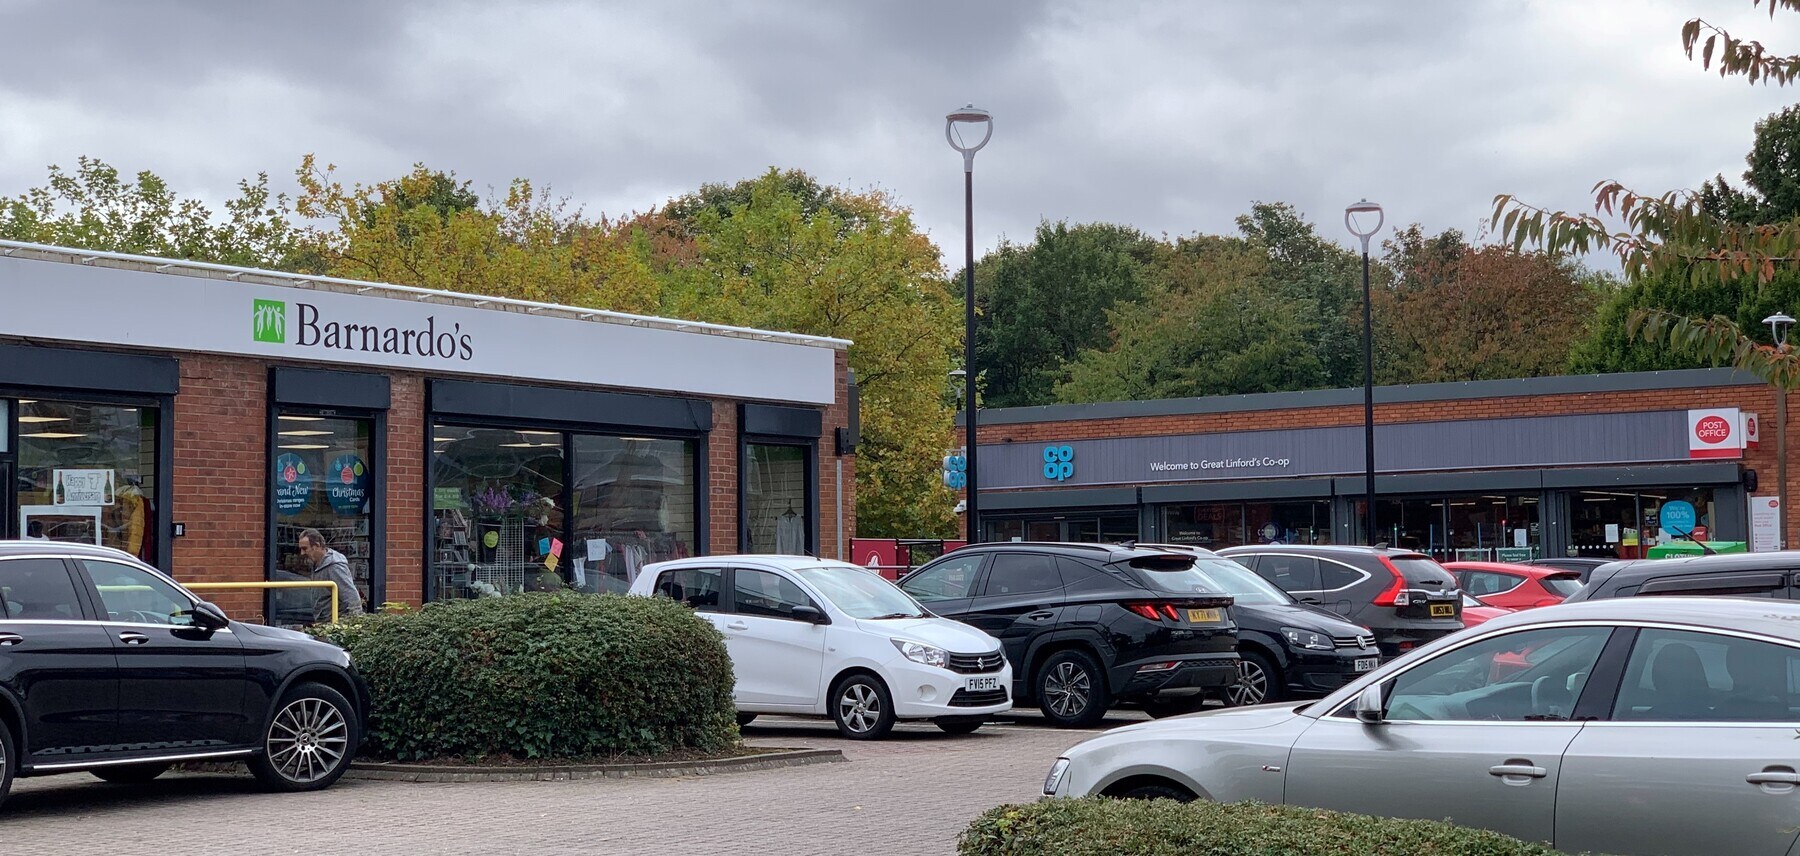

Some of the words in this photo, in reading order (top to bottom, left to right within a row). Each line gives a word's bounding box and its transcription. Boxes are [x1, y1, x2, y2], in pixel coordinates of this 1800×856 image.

[296, 303, 473, 361] Barnardo's
[1699, 429, 1726, 437] OFFICE
[1150, 462, 1188, 471] Welcome
[1200, 460, 1224, 469] Great
[1226, 458, 1260, 468] Linford's
[1262, 457, 1290, 467] Co-op
[276, 485, 291, 496] rand
[292, 484, 308, 496] New
[332, 487, 364, 498] Christmas
[1666, 511, 1690, 519] 100%
[970, 679, 984, 689] FV15
[984, 678, 996, 688] PFZ
